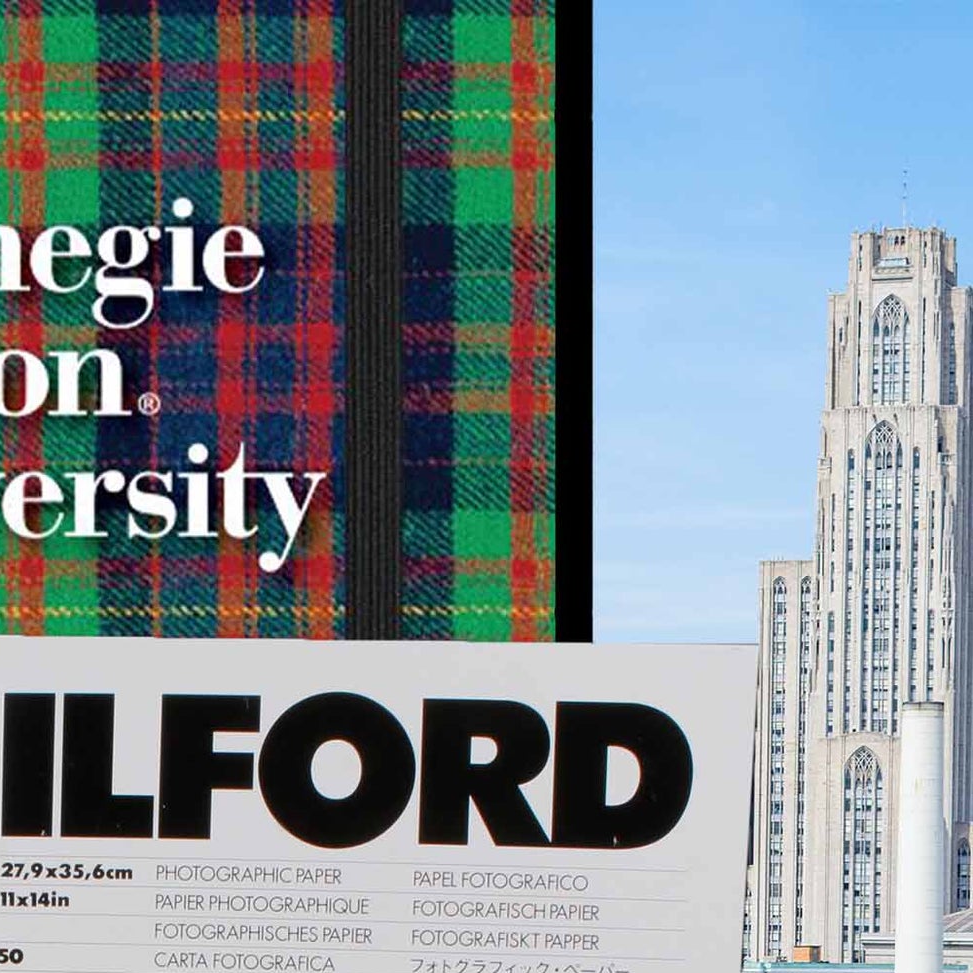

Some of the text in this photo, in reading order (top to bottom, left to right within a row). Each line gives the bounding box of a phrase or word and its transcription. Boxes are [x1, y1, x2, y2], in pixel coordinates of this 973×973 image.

[1, 691, 694, 850] ILFORD
[155, 864, 343, 885] PHOTOGRAPHIC PAPER
[413, 870, 589, 892] PAPEL FOTOGRAFICO
[0, 891, 70, 908] 11x14in
[154, 893, 371, 915] PAPIER PHOTOGRAPHIQUE
[412, 899, 600, 922] FOTOGRAFISCH PAPIER
[154, 922, 373, 944] FOTOGRAPHISCHES PAPIER
[411, 929, 600, 951] FOTOGRAFISKT PAPPER
[153, 951, 336, 973] CARTA FOTOGRAFICA
